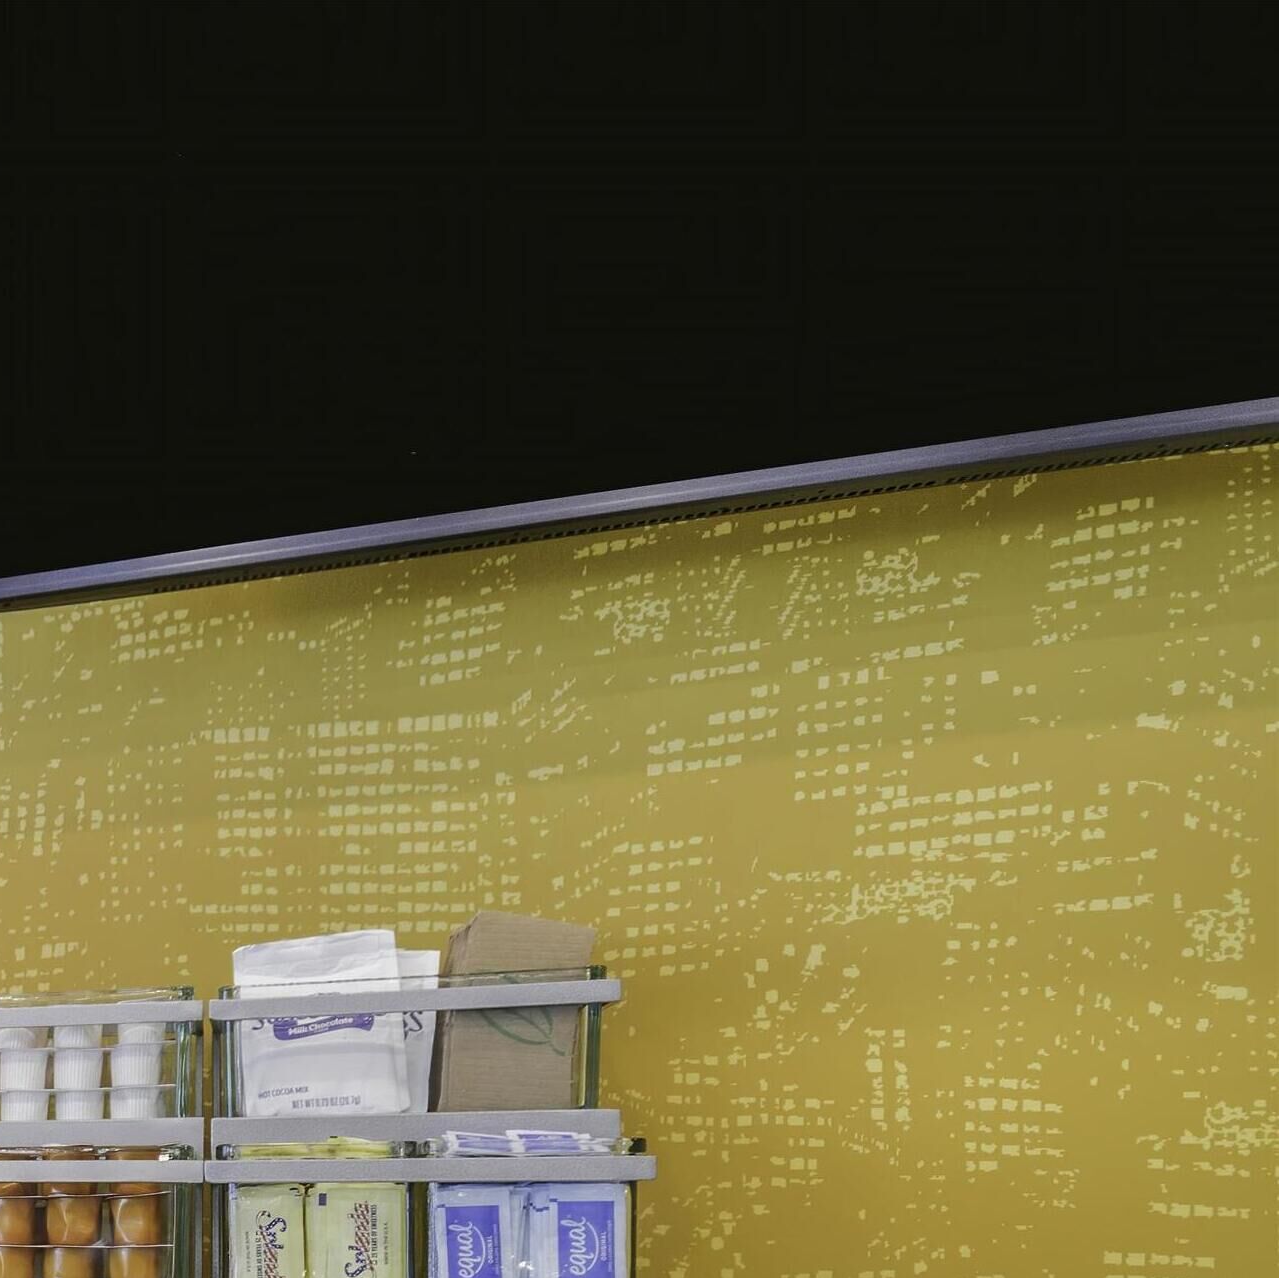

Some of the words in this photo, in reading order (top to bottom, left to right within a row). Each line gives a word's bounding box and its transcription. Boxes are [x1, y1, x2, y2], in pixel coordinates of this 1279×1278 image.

[308, 1016, 354, 1033] Chocolate
[272, 1087, 294, 1097] COCOA
[448, 1221, 481, 1278] equal
[560, 1216, 594, 1276] equal
